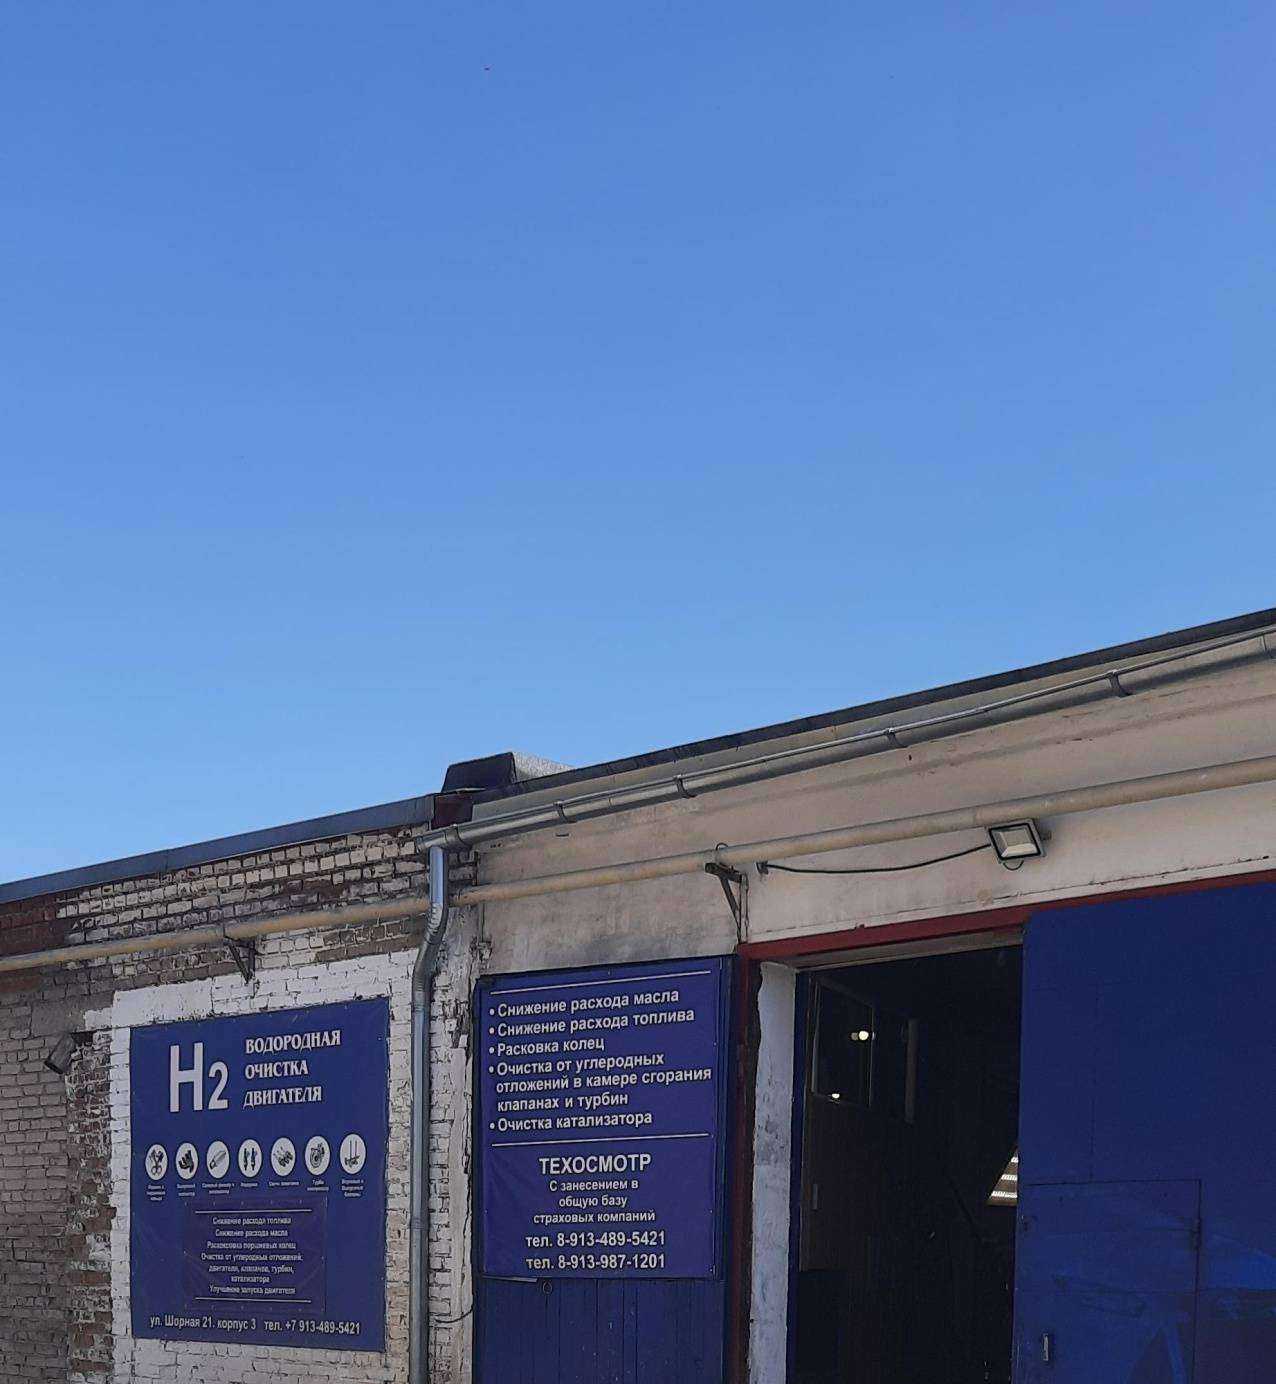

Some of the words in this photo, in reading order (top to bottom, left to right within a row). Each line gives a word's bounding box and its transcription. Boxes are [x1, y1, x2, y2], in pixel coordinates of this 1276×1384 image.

[497, 1000, 567, 1018] Снижение
[571, 994, 629, 1016] расхода
[633, 989, 679, 1005] масла
[497, 1019, 566, 1037] Снижение
[570, 1013, 629, 1034] расхода
[632, 1009, 695, 1026] топлива
[245, 1029, 341, 1055] ВОДОРОДНАЯ
[497, 1041, 559, 1056] Расковка
[563, 1037, 605, 1053] колец
[245, 1060, 309, 1080] ОЧИСТКА
[497, 1061, 552, 1076] Очистка
[556, 1059, 572, 1072] от
[576, 1053, 664, 1074] углеродных
[496, 1075, 569, 1093] отложений
[573, 1077, 582, 1088] в
[586, 1071, 637, 1088] камере
[641, 1068, 712, 1085] сгорания
[243, 1086, 322, 1109] ДВИГАТЕЛЯ
[497, 1097, 559, 1112] клапанах
[565, 1096, 574, 1108] и
[577, 1092, 629, 1109] турбин
[498, 1117, 552, 1132] Очистка
[556, 1111, 652, 1129] катализатора
[538, 1153, 652, 1175] ТЕХОСМОТР
[549, 1180, 558, 1192] С
[560, 1179, 628, 1192] занесением
[631, 1179, 639, 1189] в
[559, 1195, 599, 1210] общую
[601, 1194, 628, 1208] базу
[533, 1213, 594, 1226] страховых
[597, 1209, 656, 1223] компаний
[525, 1235, 553, 1248] тел.
[557, 1230, 666, 1247] 8-913-489-5421
[525, 1257, 554, 1270] тел.
[558, 1253, 666, 1269] 8-913-987-1201
[150, 1315, 163, 1329] ул.
[164, 1314, 200, 1329] Шорная
[217, 1319, 248, 1335] корпус
[250, 1319, 257, 1330] 3
[263, 1321, 283, 1332] тел.
[285, 1320, 297, 1331] +7
[299, 1320, 361, 1335] 913-489-5421
